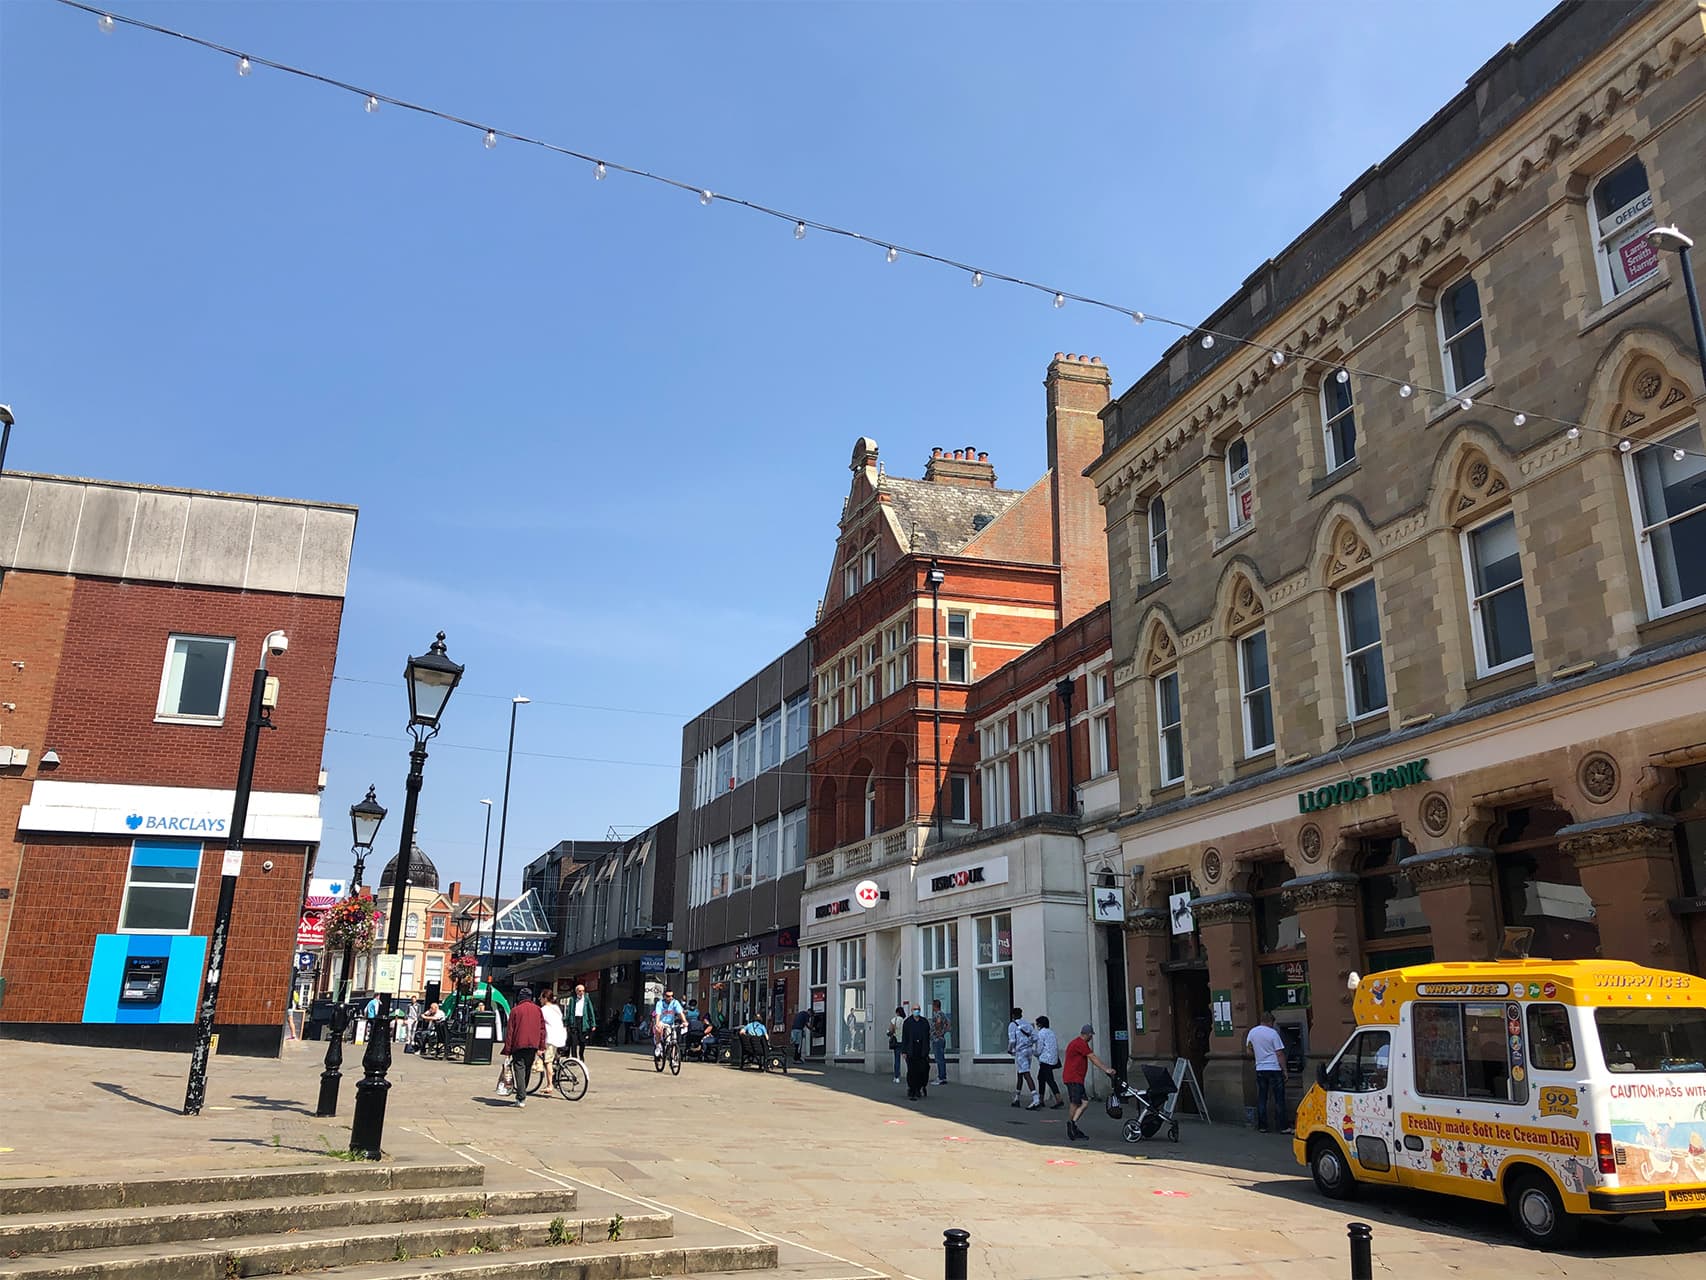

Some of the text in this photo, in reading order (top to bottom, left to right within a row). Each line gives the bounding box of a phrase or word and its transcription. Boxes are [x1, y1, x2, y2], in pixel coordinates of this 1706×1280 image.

[1615, 195, 1653, 225] OFFICES
[1624, 240, 1648, 258] Lamb
[1627, 247, 1652, 267] Smith
[1298, 758, 1432, 814] LLOYDS BANK
[146, 816, 225, 831] BARCLAYS
[969, 866, 985, 883] UK
[1425, 984, 1468, 994] WHIPPY
[1471, 984, 1499, 994] ICES
[1594, 975, 1691, 988] WHIPPY ICES
[1545, 1092, 1570, 1106] 99
[1658, 1086, 1683, 1098] PASS
[1408, 1115, 1581, 1151] Freshly made Soft Ice Cream Daily
